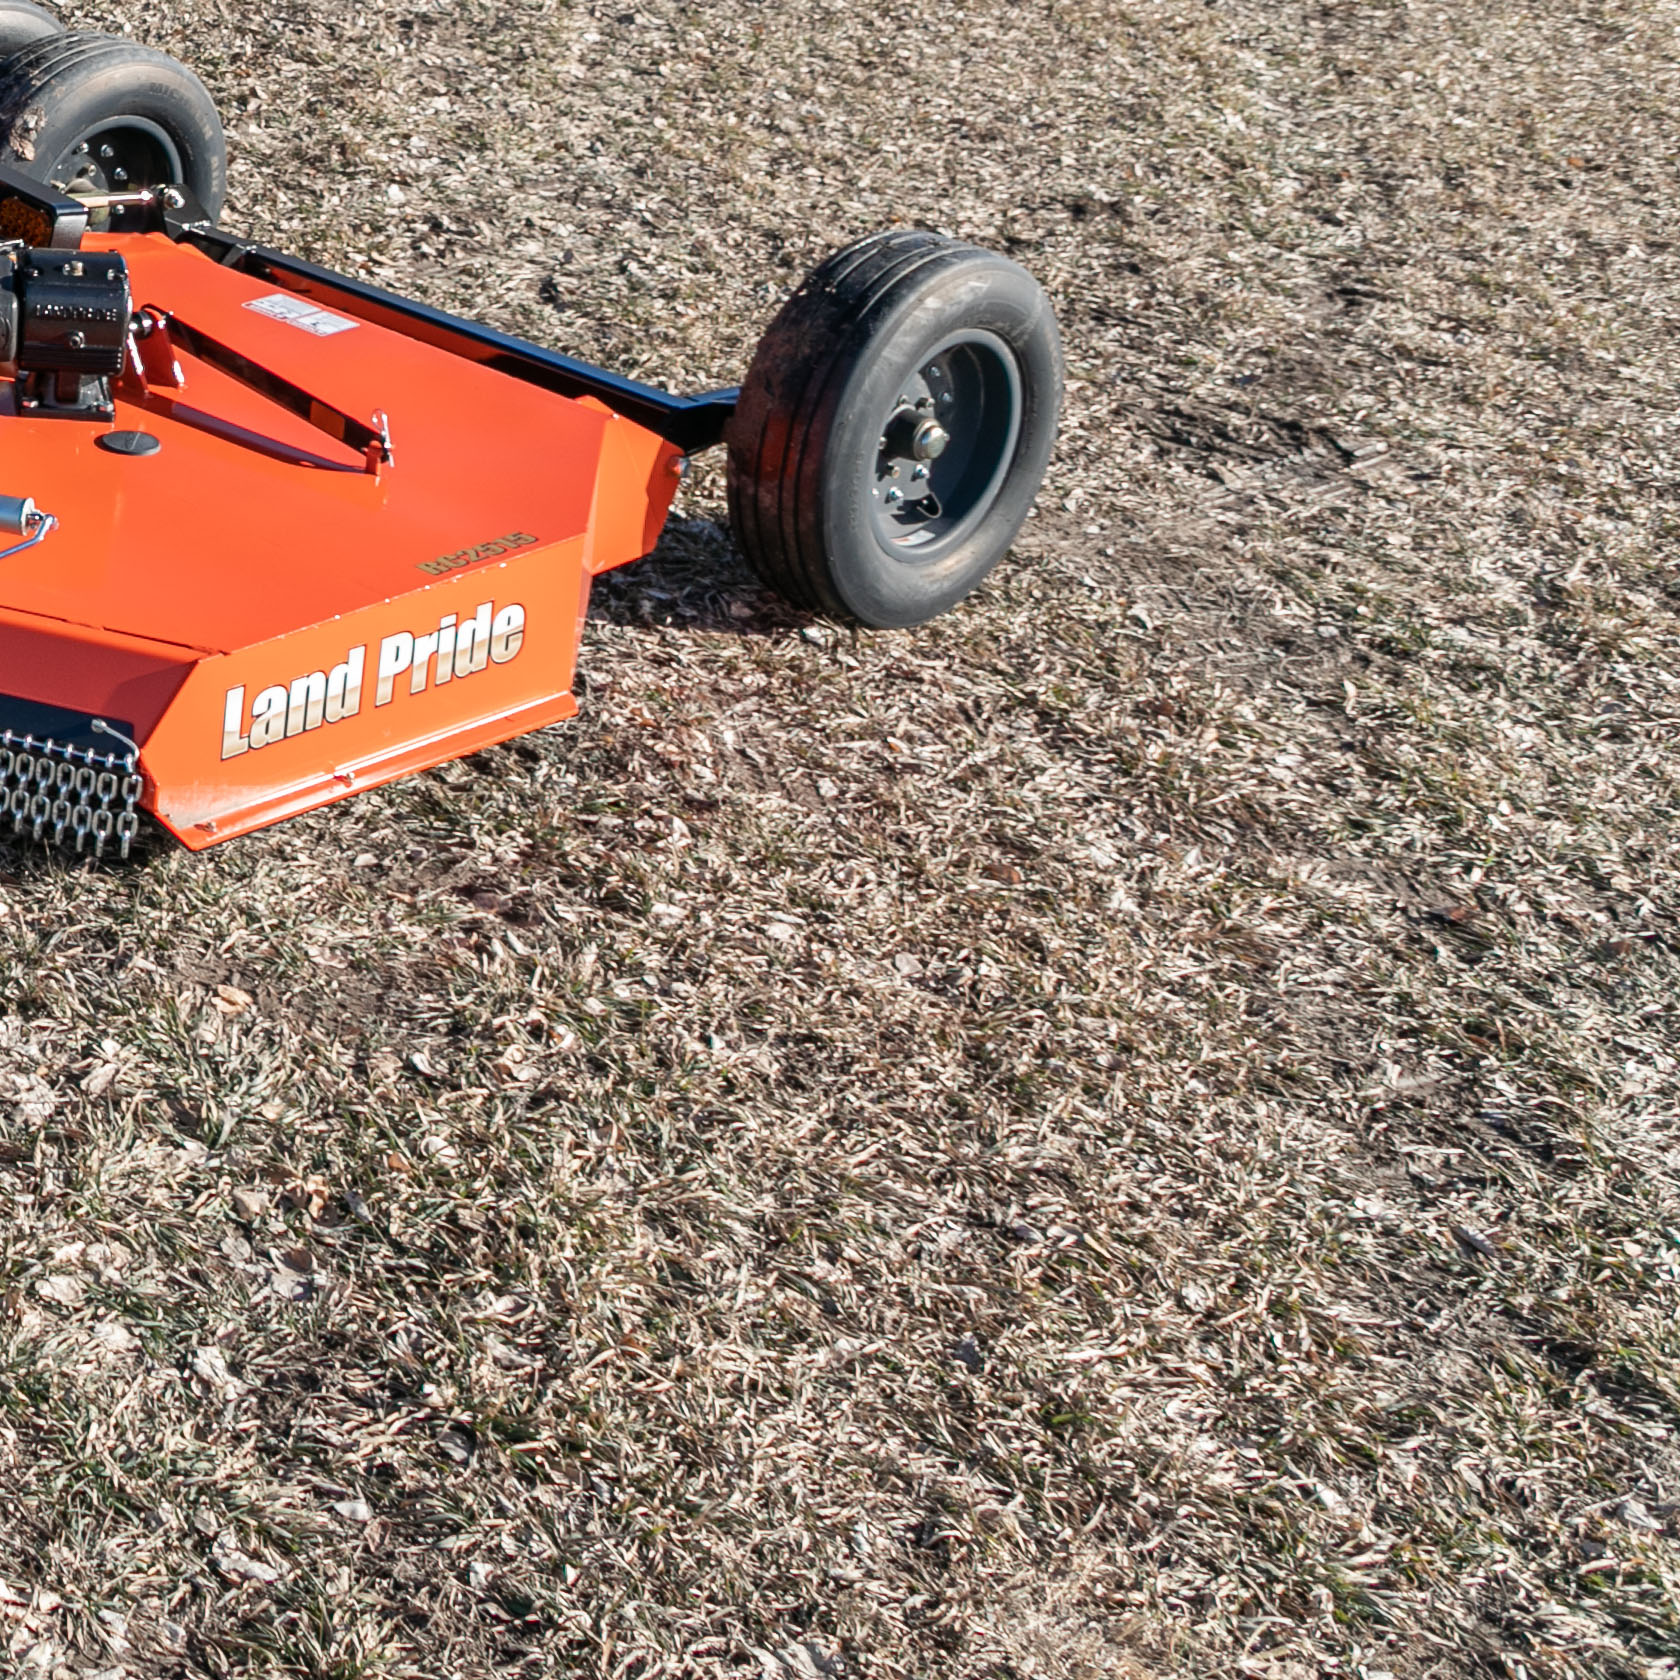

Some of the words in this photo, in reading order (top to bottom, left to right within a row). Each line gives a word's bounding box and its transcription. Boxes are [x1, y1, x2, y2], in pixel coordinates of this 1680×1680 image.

[416, 532, 538, 575] RC2515
[221, 645, 366, 760] Land
[375, 601, 525, 707] Pride
